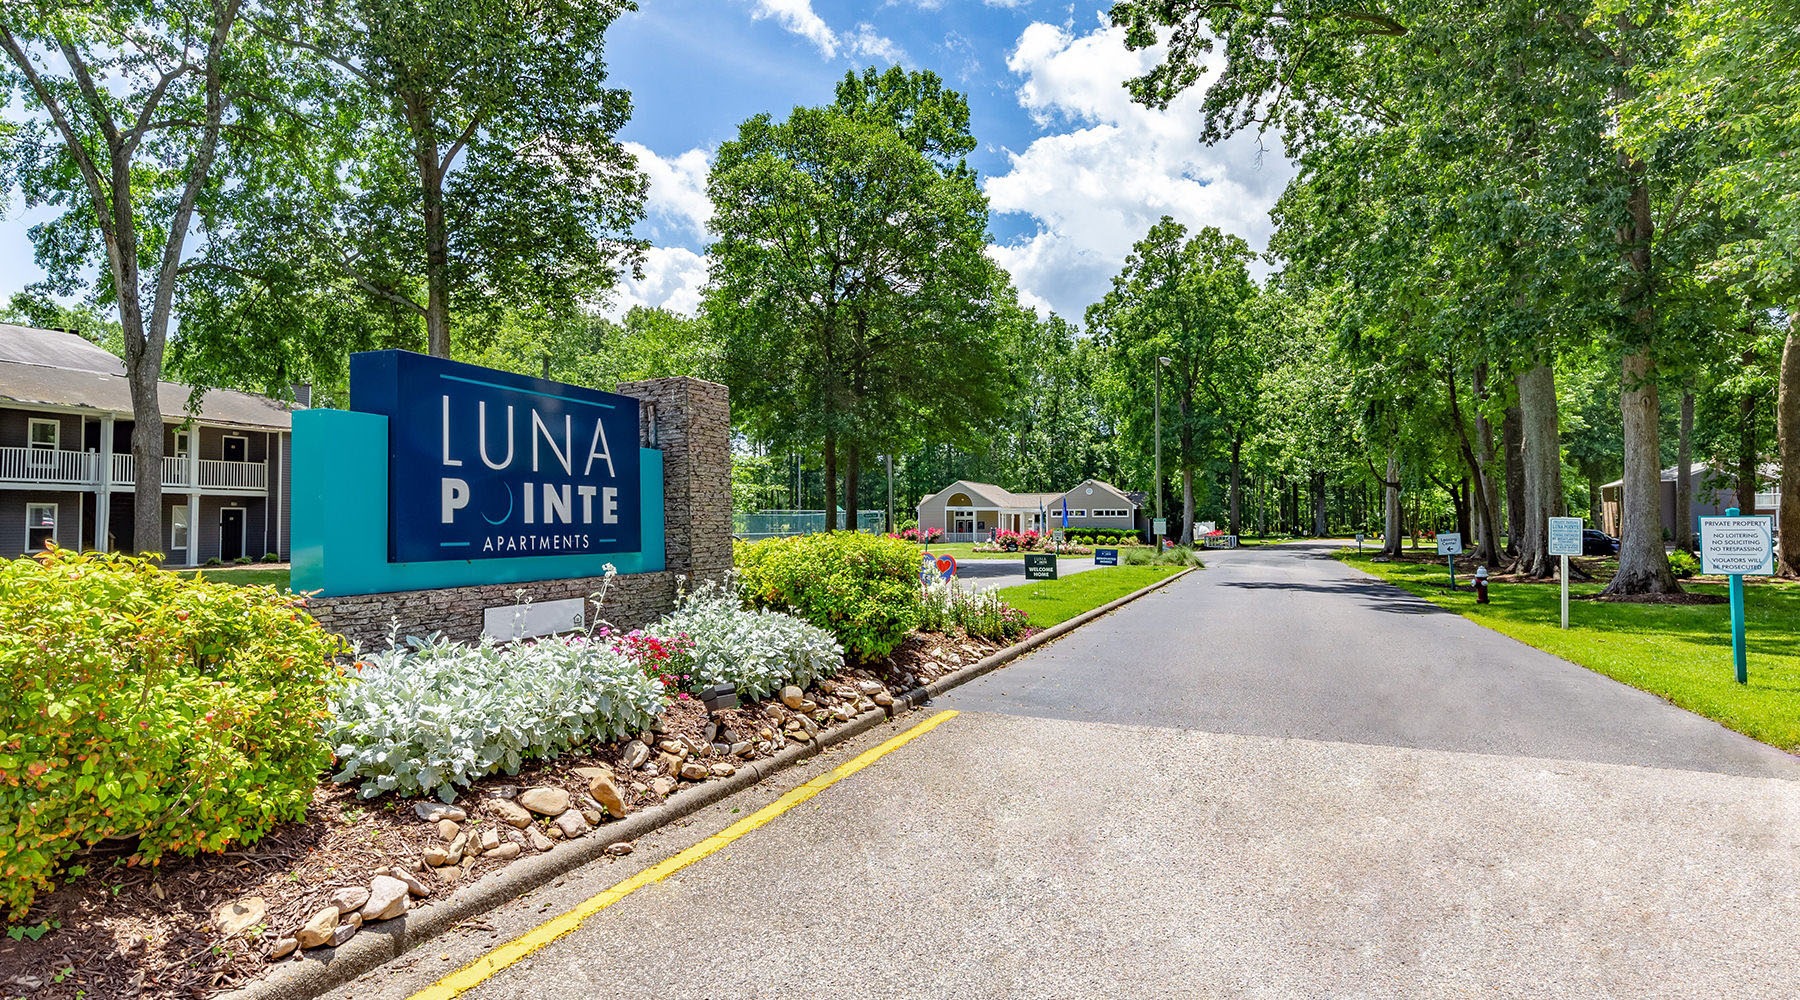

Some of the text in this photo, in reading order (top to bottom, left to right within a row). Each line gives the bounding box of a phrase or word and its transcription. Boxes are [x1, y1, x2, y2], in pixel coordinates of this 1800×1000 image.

[442, 394, 616, 478] LUNA
[441, 477, 618, 525] POINTE
[483, 534, 590, 552] APARTMENTS
